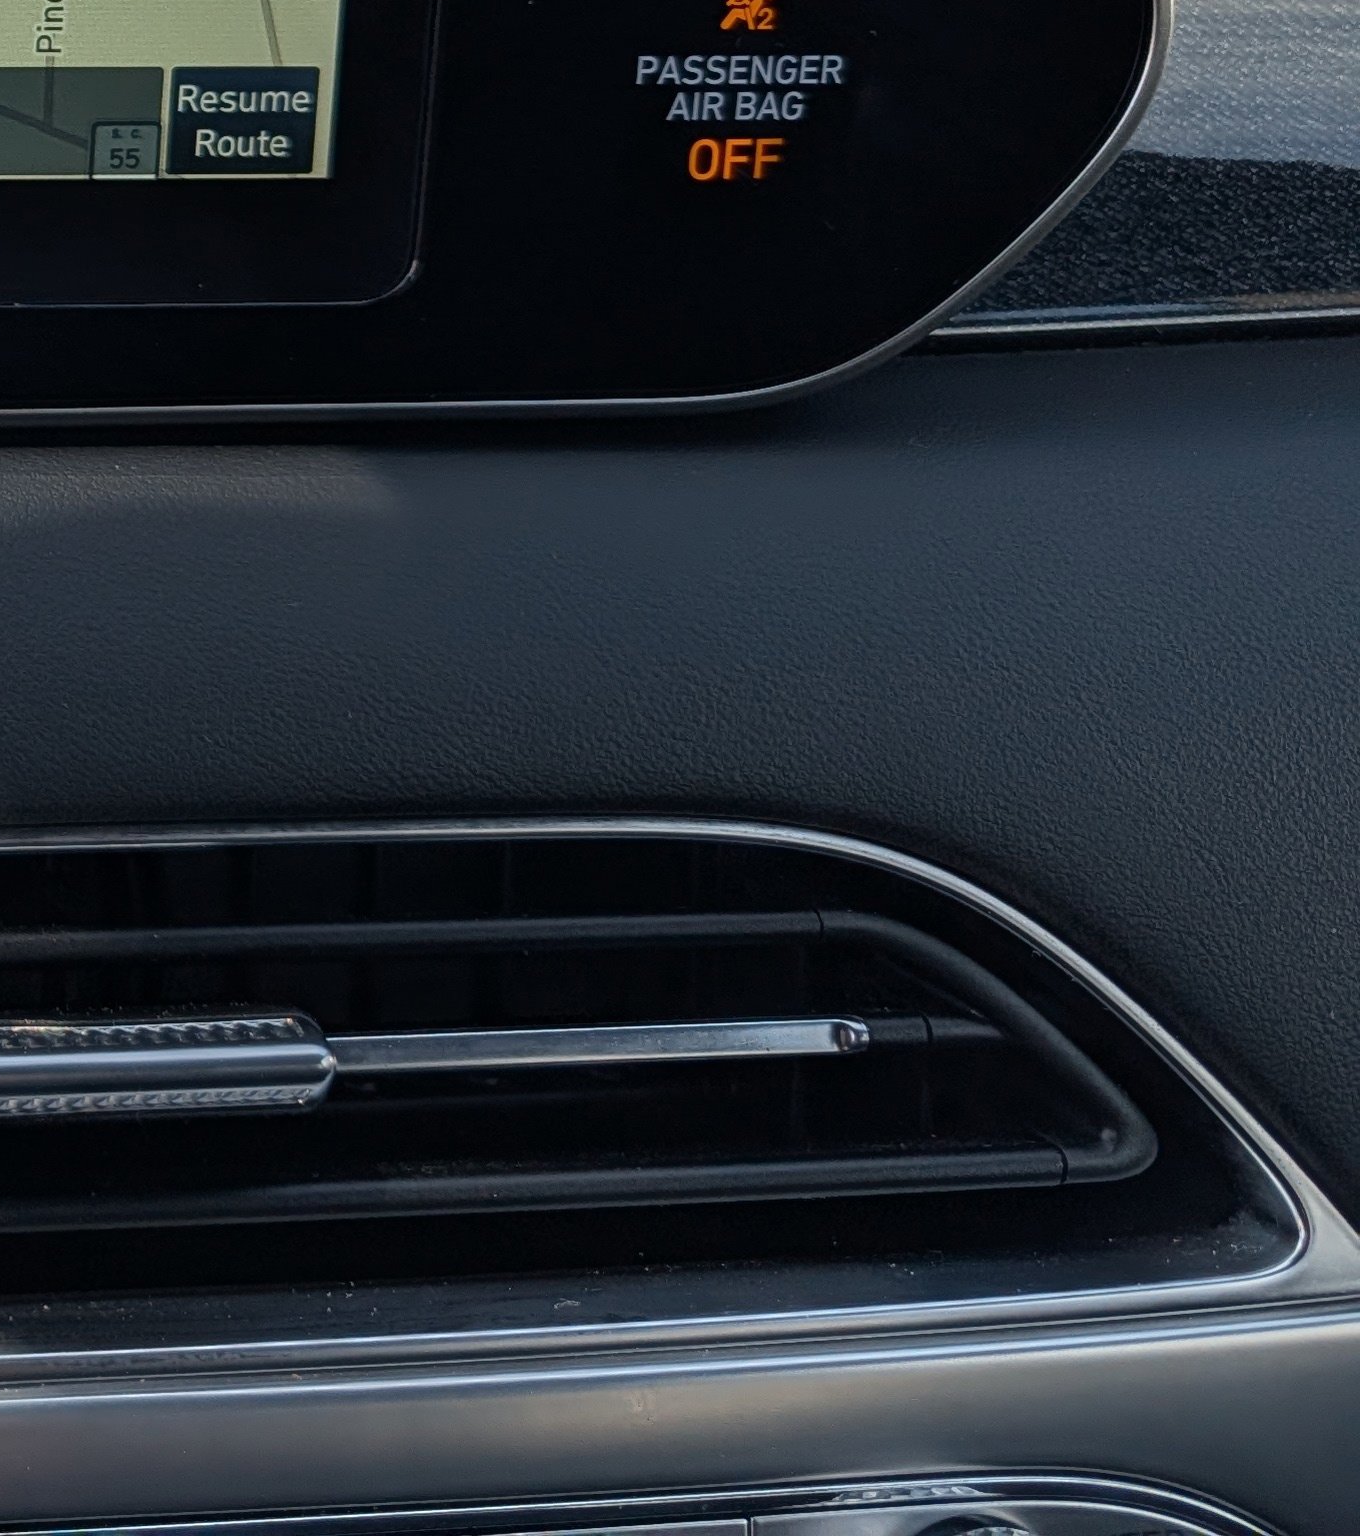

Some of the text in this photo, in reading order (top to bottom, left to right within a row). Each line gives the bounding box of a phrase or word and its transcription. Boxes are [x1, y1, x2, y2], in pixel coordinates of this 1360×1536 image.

[635, 55, 845, 85] PASSENGER
[177, 84, 312, 114] Resume
[665, 92, 806, 121] AIR BAG
[195, 128, 292, 158] Route
[109, 148, 141, 170] 55
[688, 138, 784, 181] OFF
